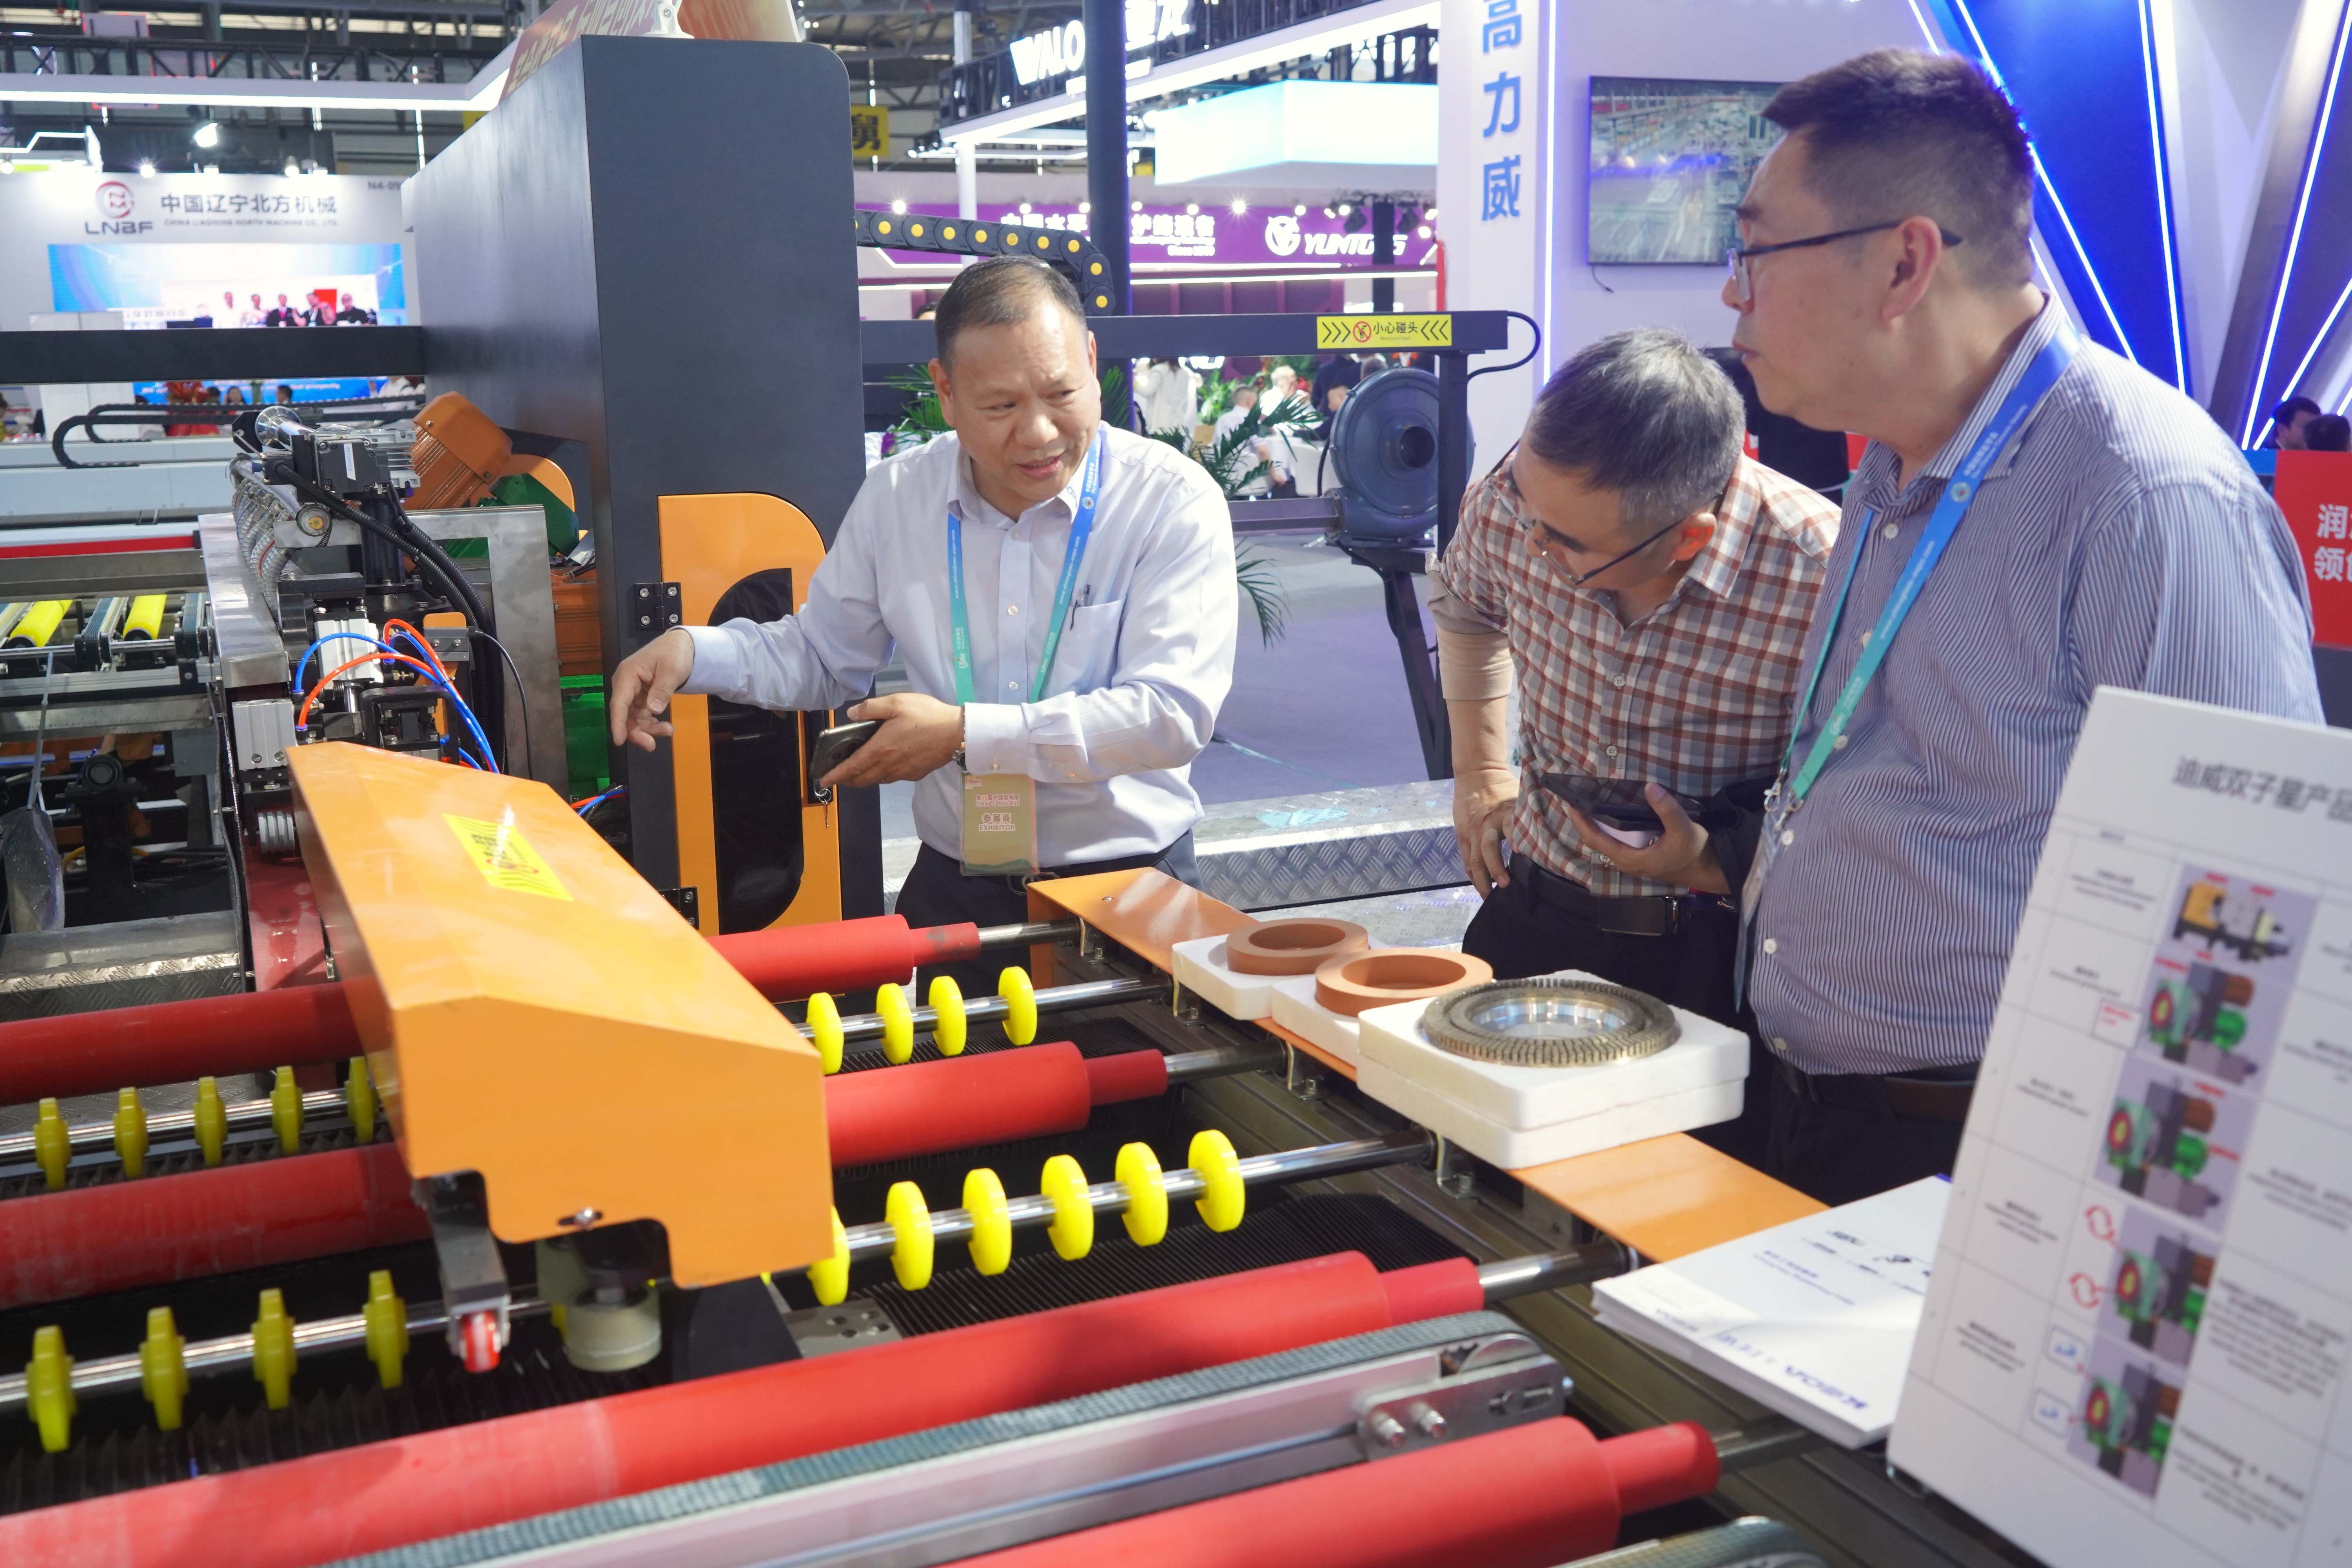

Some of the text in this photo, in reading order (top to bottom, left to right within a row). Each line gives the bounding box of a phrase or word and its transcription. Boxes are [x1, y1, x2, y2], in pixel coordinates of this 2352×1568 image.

[1482, 0, 1522, 221] 高力威
[161, 194, 337, 213] 中国辽宁北方机械
[85, 221, 153, 234] LNBF
[1373, 321, 1418, 334] 小心碰头
[2317, 503, 2352, 539] 润
[983, 813, 1011, 823] 参展商
